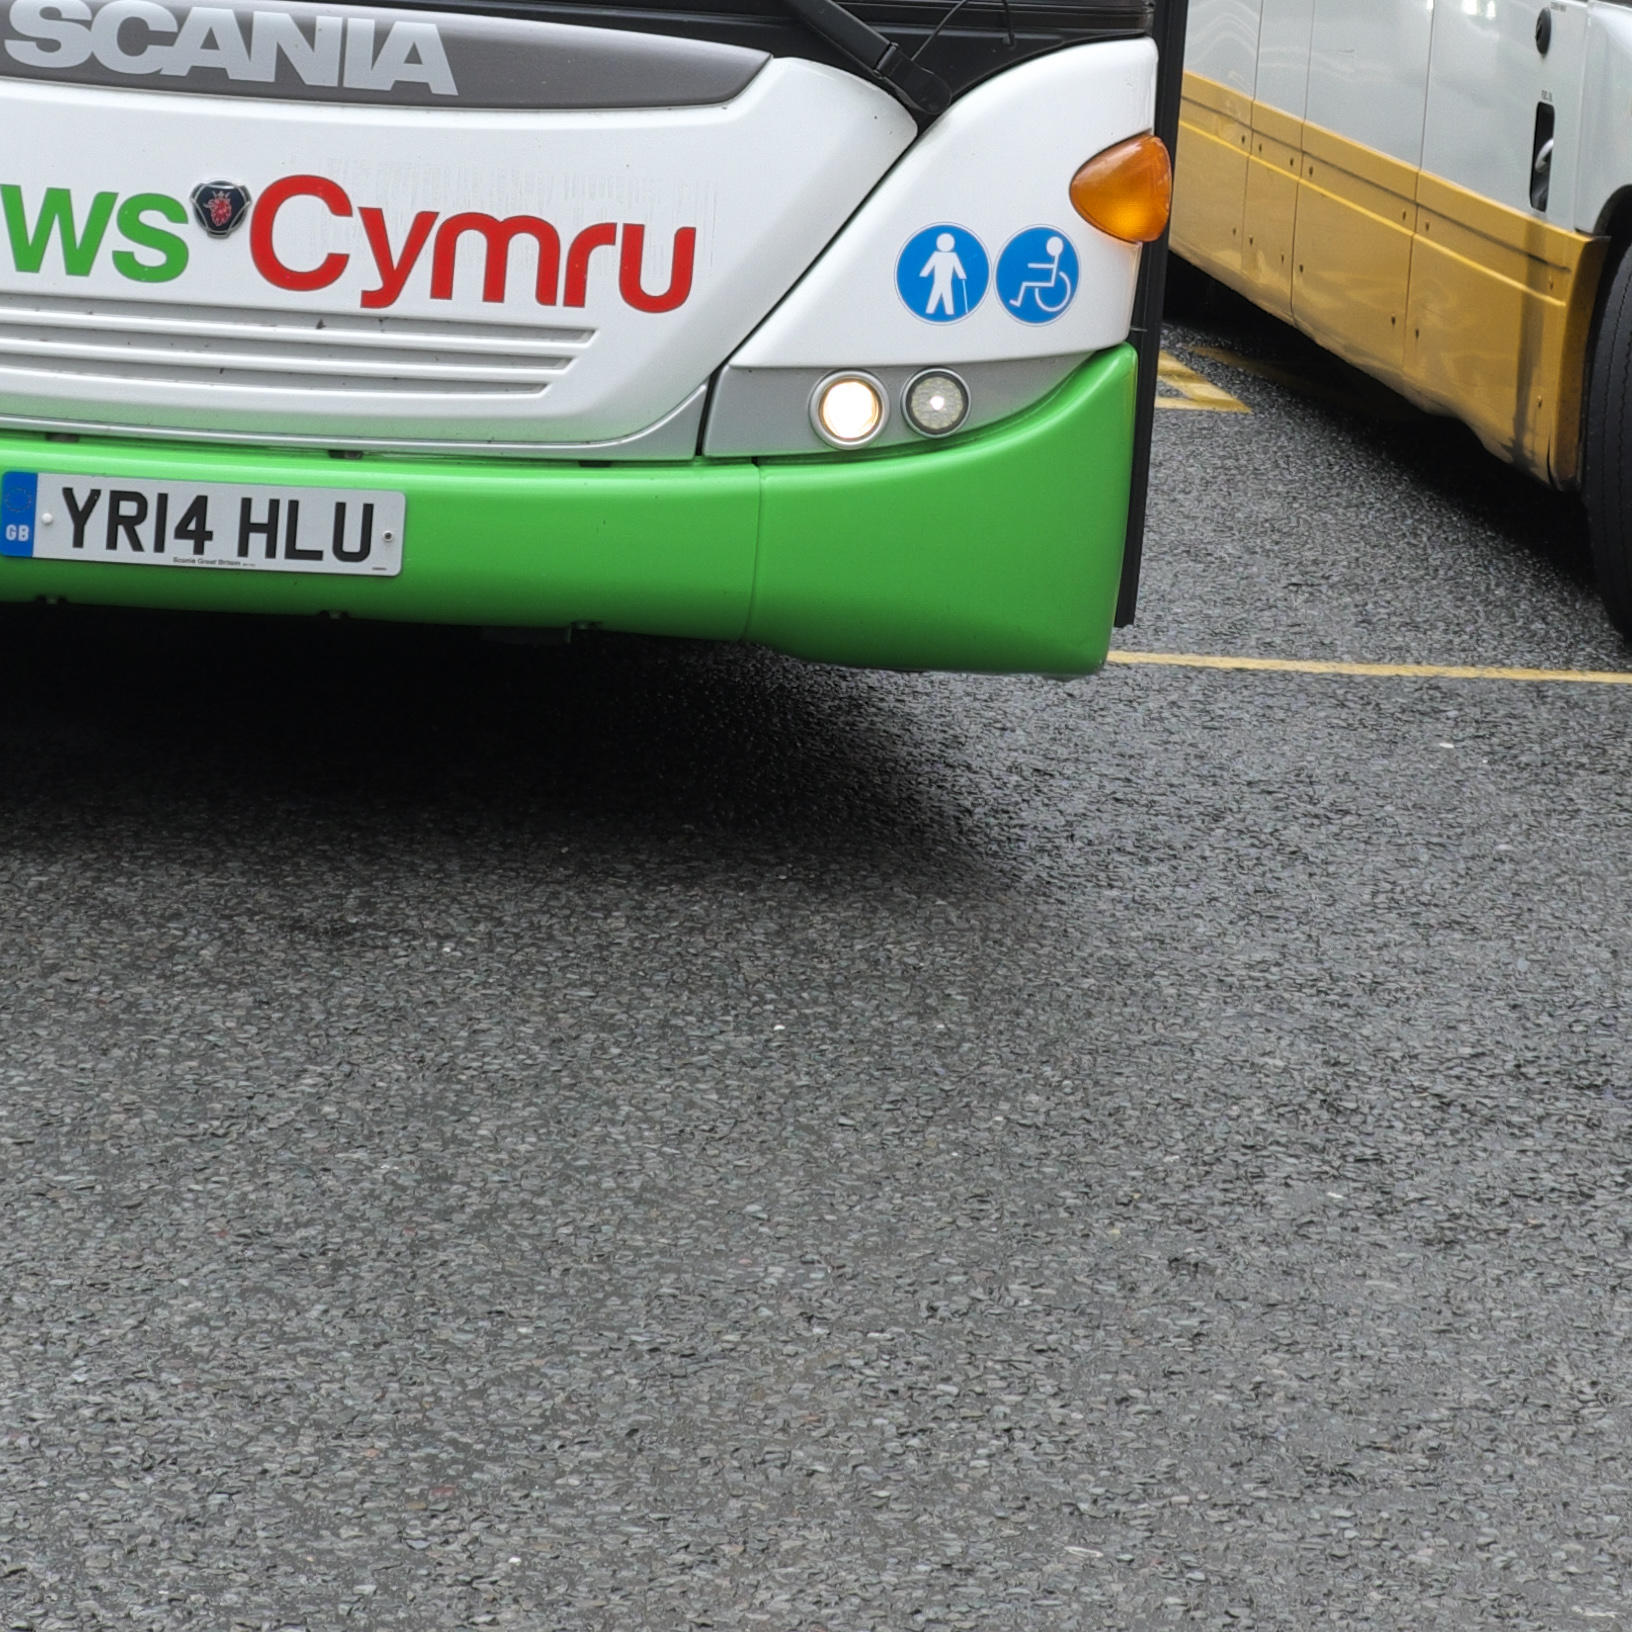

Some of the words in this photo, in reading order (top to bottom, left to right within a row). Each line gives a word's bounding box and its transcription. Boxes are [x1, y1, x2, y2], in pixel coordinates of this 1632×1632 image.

[4, 523, 31, 543] GB
[61, 486, 214, 556] YR14
[236, 496, 375, 564] HLU
